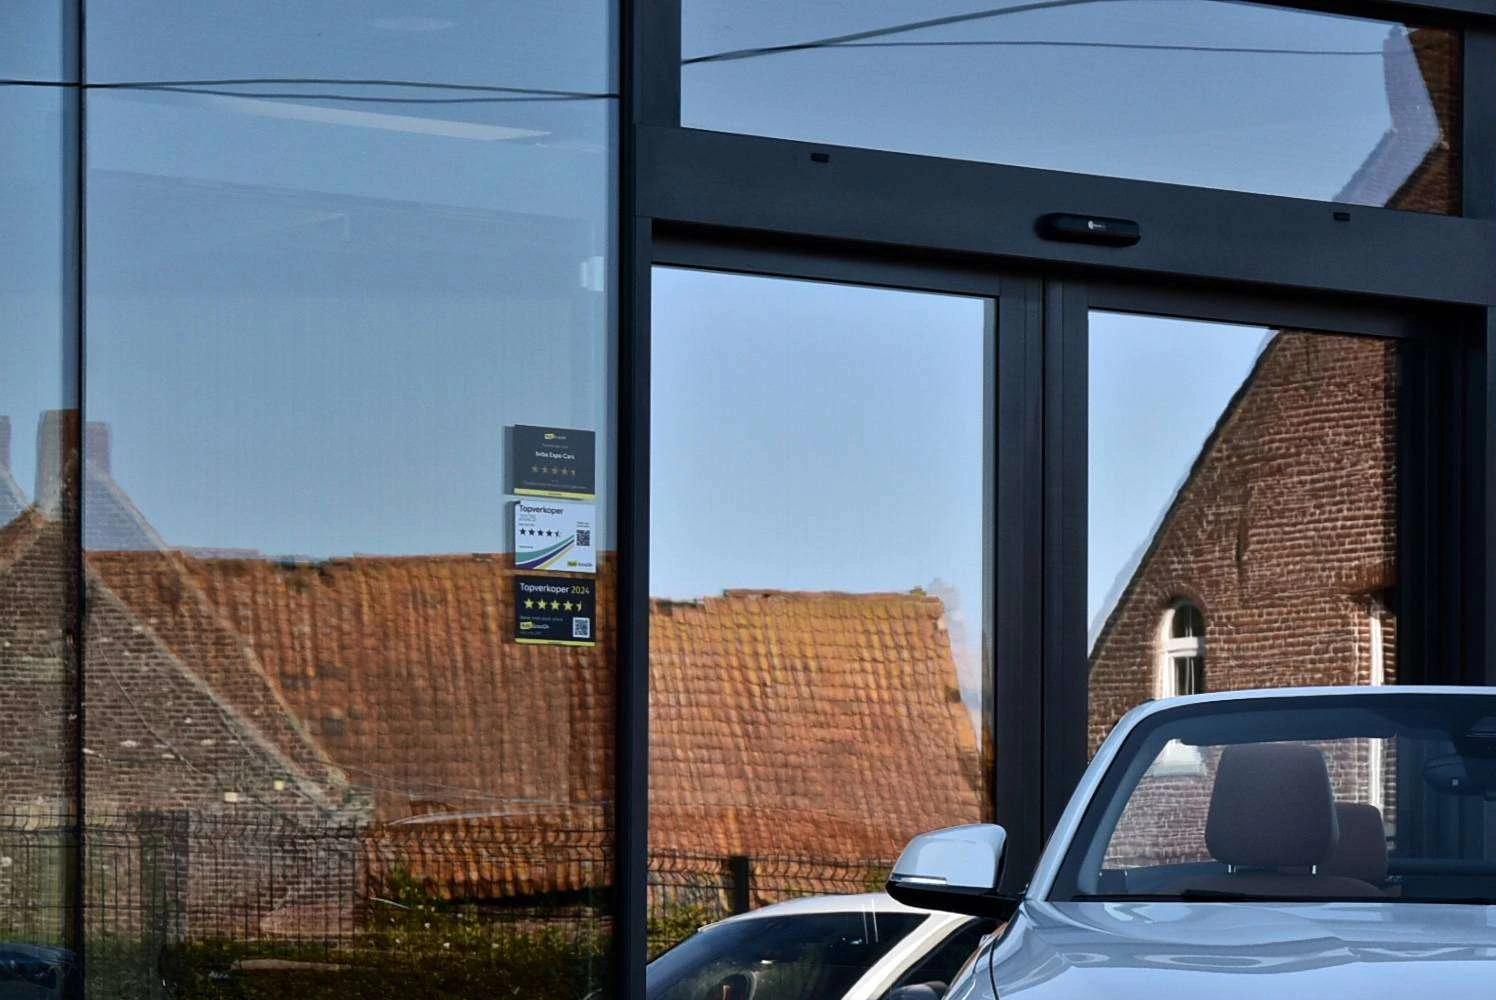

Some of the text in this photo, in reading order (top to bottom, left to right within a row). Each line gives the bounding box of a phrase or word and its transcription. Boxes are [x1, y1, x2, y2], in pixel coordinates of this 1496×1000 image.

[519, 504, 564, 515] Topverkoper
[520, 583, 590, 594] Topverkoper 2024
